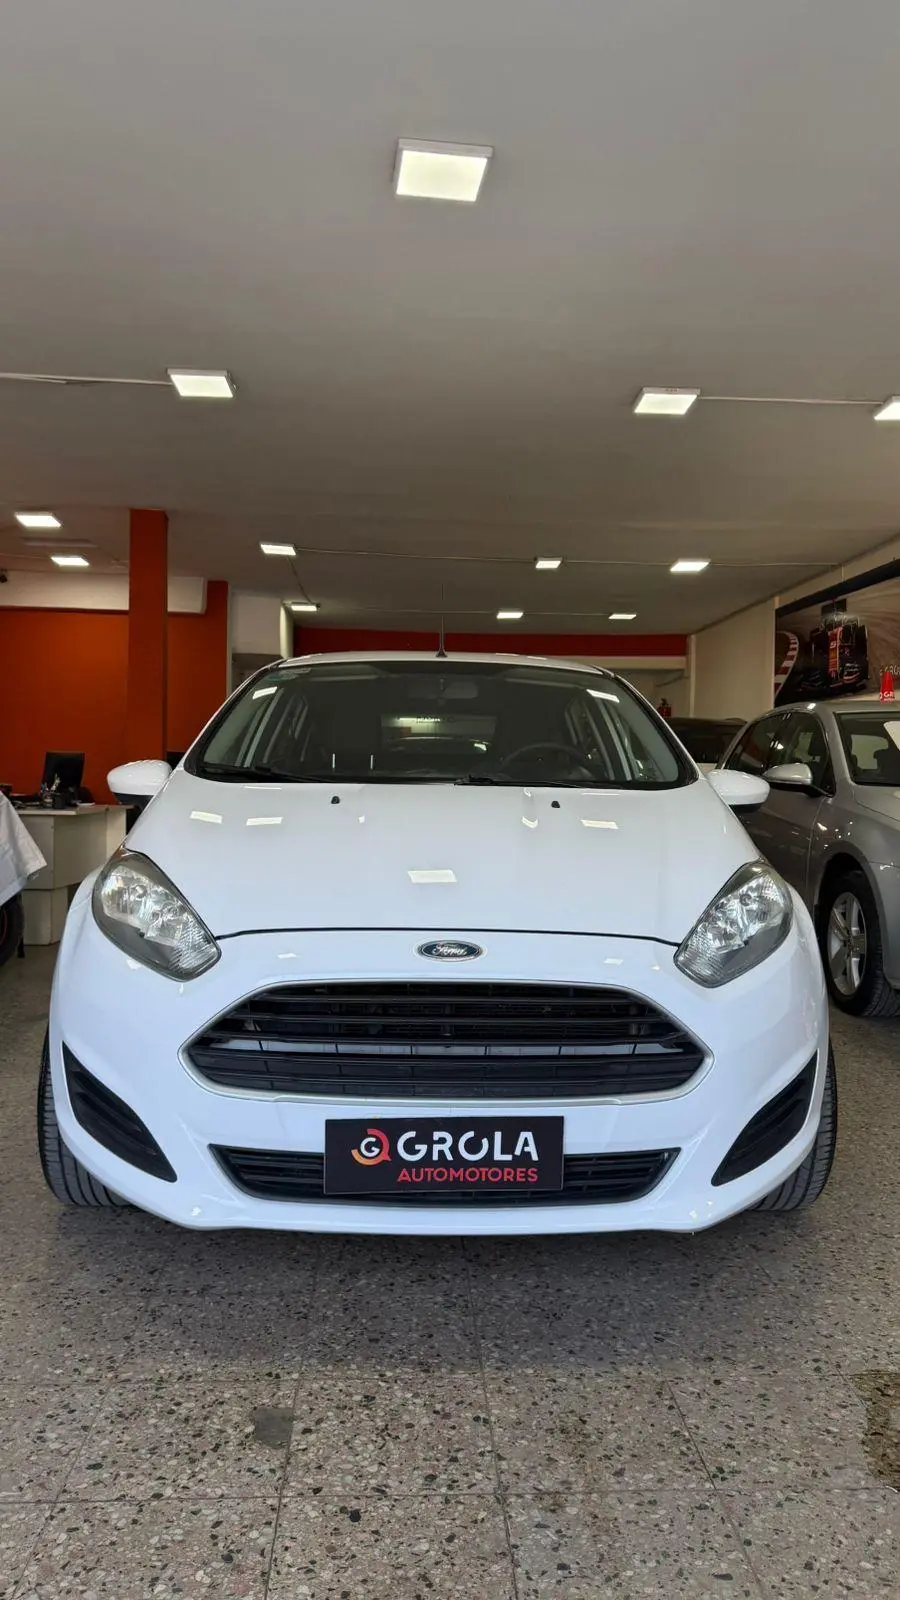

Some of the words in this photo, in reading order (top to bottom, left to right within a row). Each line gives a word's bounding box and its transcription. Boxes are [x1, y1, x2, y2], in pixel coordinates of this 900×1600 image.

[432, 943, 468, 956] Ford
[397, 1130, 539, 1162] GROLA
[397, 1167, 538, 1182] AUTOMOTORES
